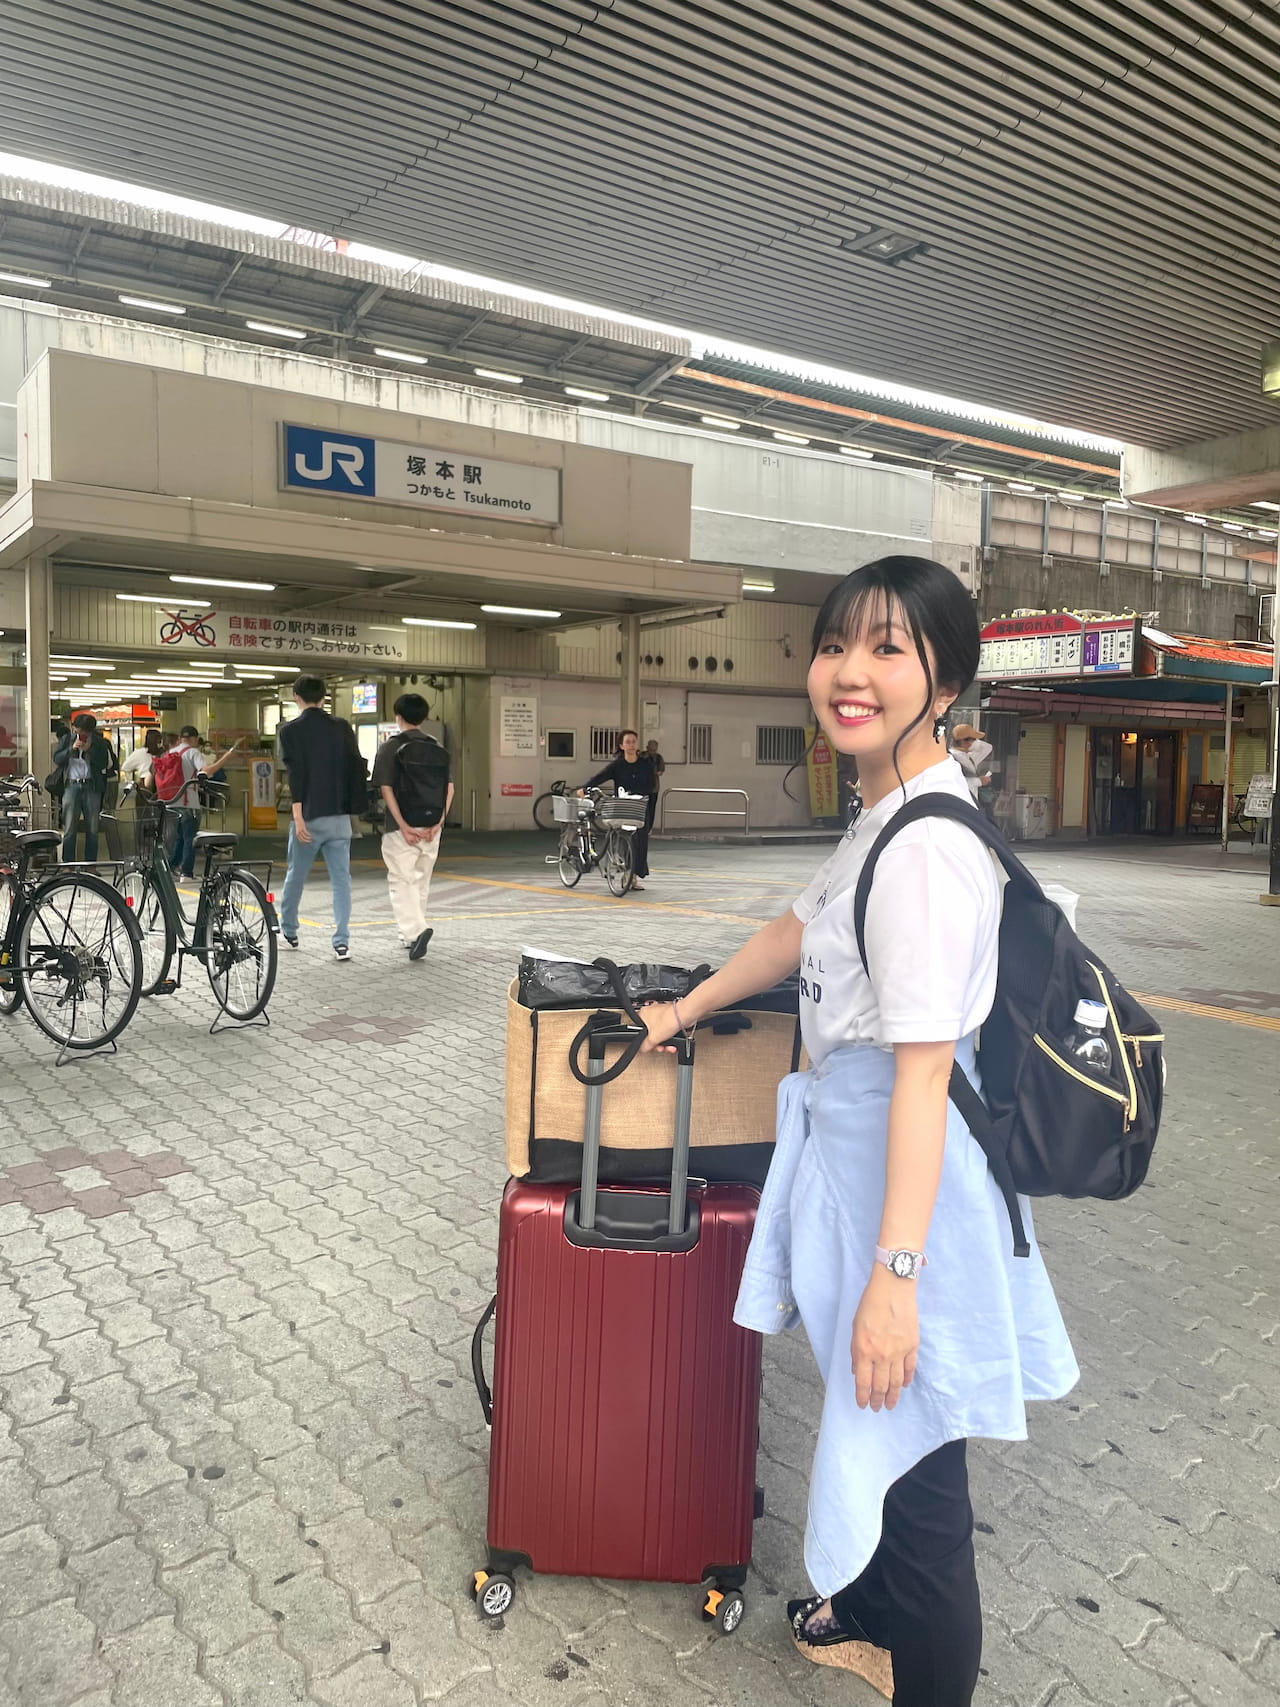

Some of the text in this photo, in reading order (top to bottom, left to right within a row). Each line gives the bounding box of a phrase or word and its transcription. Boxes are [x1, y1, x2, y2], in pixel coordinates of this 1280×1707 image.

[295, 441, 365, 487] JR
[406, 456, 482, 485] 塚本駅
[406, 482, 532, 512] つかもと Tsukamoto
[229, 616, 357, 637] 自転車の駅内通行は
[228, 634, 403, 658] 危険ですから、おやめ下さい。
